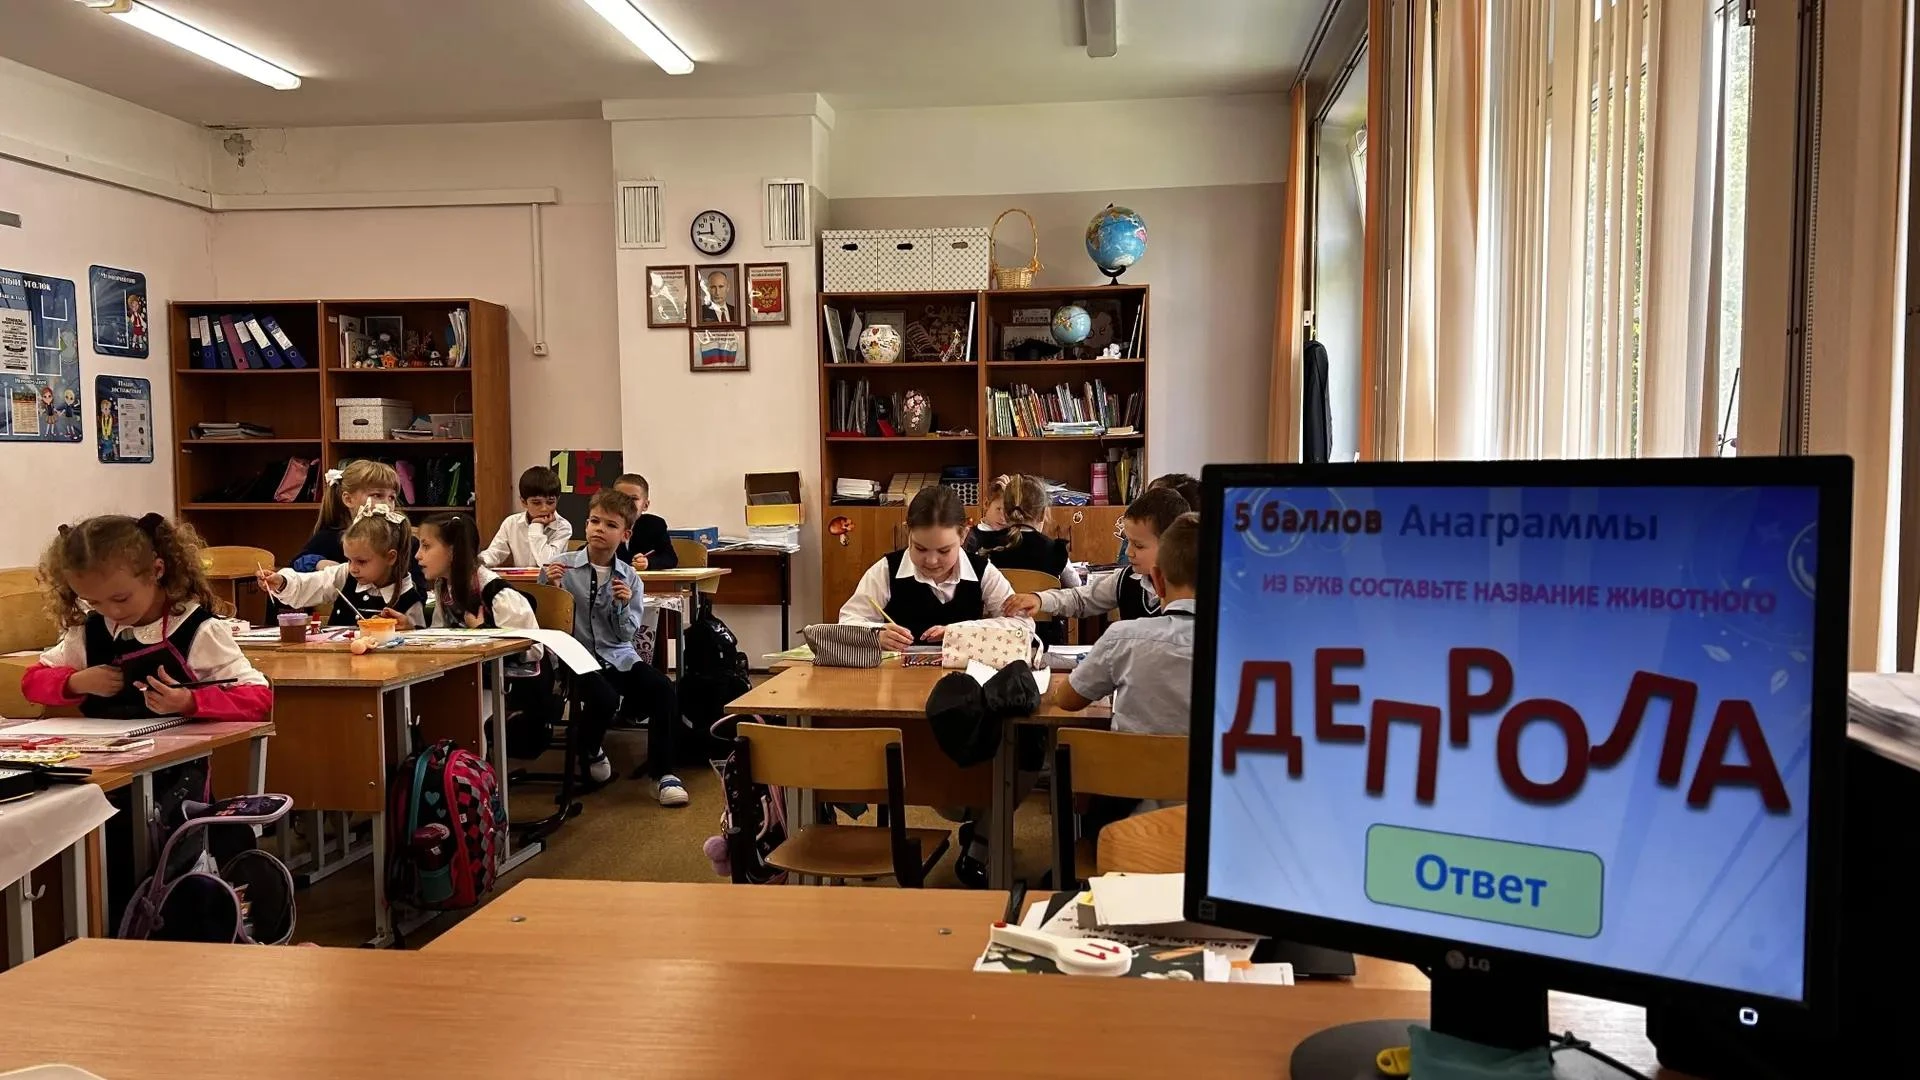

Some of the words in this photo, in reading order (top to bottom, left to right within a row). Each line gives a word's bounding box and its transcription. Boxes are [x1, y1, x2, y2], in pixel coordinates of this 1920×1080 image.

[1234, 502, 1250, 532] 5
[1260, 501, 1383, 535] баллов
[1399, 504, 1658, 546] Анаграммы
[1262, 574, 1286, 593] ИЗ
[1294, 575, 1342, 595] БУКВ
[1349, 577, 1468, 601] СОСТАВЬТЕ
[1474, 582, 1600, 608] НАЗВАНИЕ
[1606, 587, 1777, 614] ЖИВОТНОГО
[1221, 647, 1792, 815] ДЕПРОЛА
[1414, 854, 1548, 909] Ответ
[1468, 956, 1491, 973] LG
